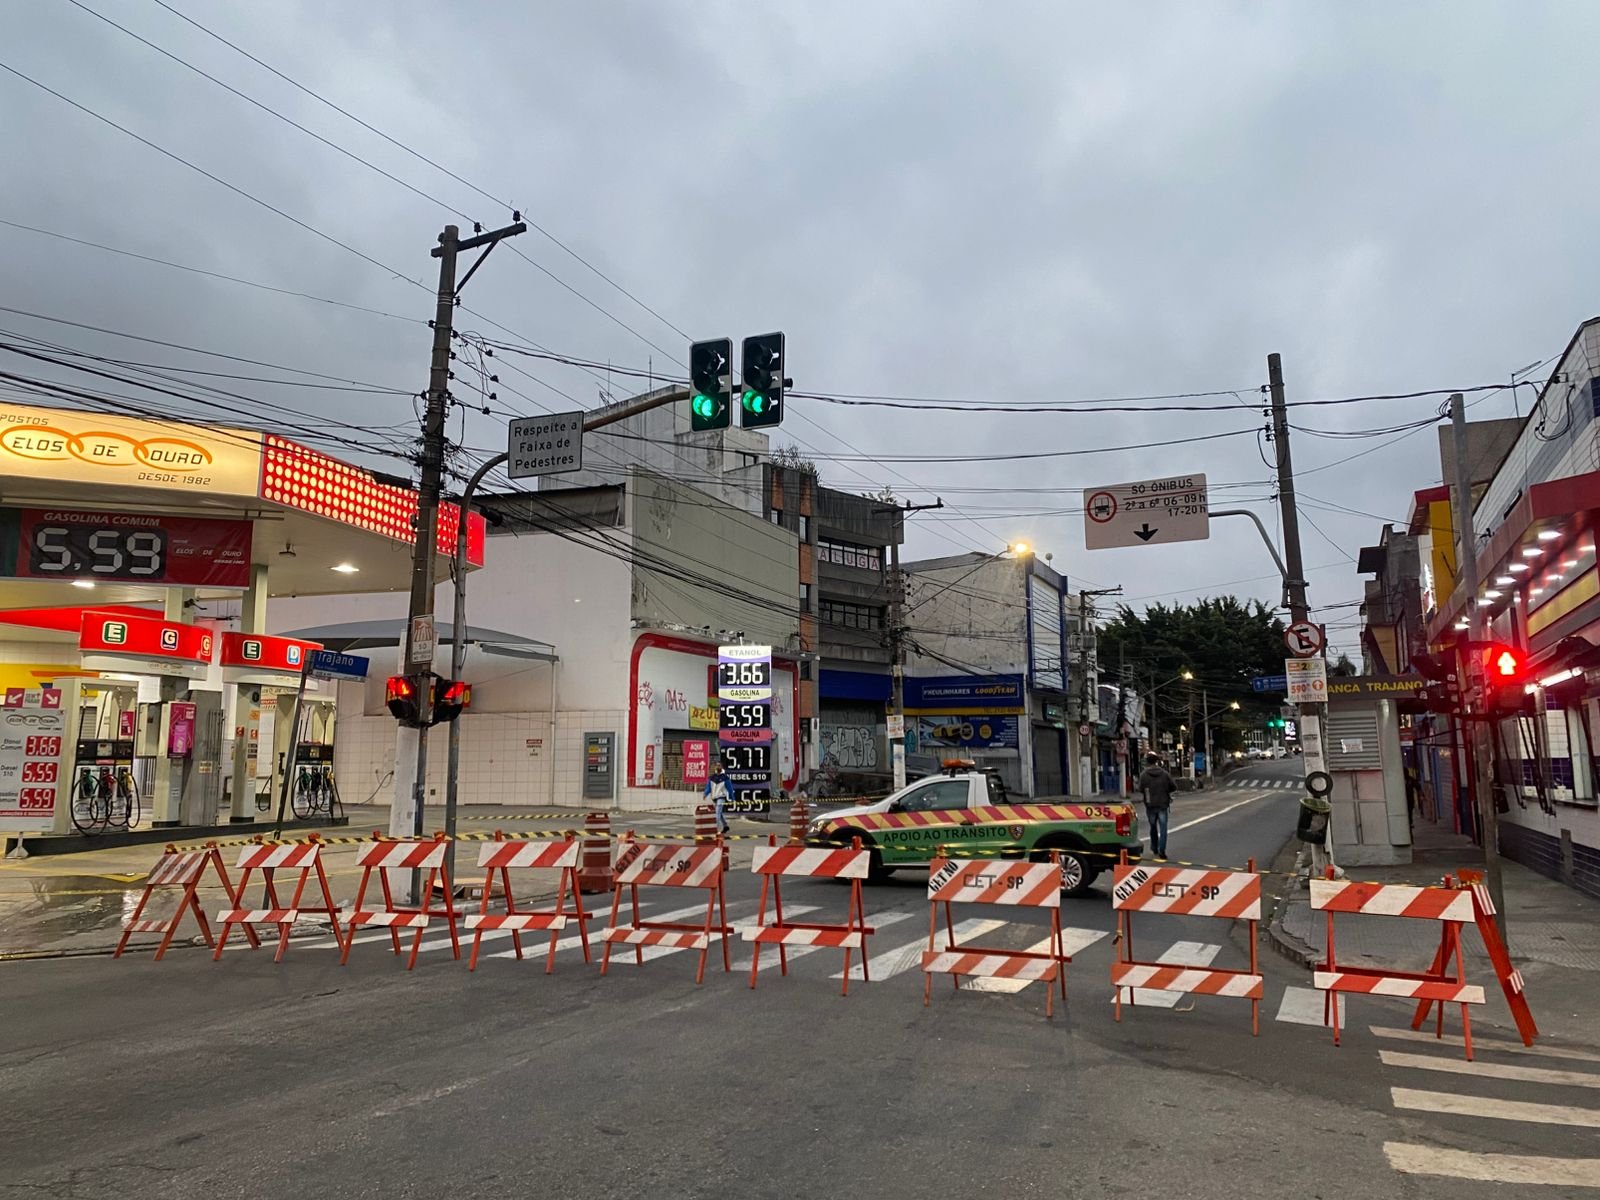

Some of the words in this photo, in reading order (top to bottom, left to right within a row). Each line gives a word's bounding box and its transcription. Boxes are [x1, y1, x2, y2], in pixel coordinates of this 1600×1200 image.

[0, 414, 49, 425] POSTOS
[514, 423, 566, 437] Respeite
[571, 422, 577, 430] a
[12, 437, 64, 452] ELOS
[93, 445, 119, 457] DE
[150, 450, 203, 465] OURO
[520, 441, 552, 453] Faixa
[556, 438, 570, 448] de
[515, 455, 574, 470] Pedestres
[138, 472, 178, 483] DESDE
[182, 476, 211, 485] 1982
[1168, 506, 1198, 517] 17-20
[44, 512, 109, 524] GASOLINA
[112, 516, 160, 527] COMUM
[37, 527, 161, 574] 5,59
[820, 550, 879, 569] ALUGA
[108, 624, 122, 638] E
[164, 632, 175, 644] G
[203, 638, 210, 650] G
[247, 643, 257, 655] E
[290, 648, 298, 659] D
[318, 651, 354, 666] Trajano
[727, 663, 763, 685] 3,66
[1327, 684, 1360, 693] ANCA
[1366, 681, 1424, 691] TRAJANO
[726, 705, 763, 727] 5,59
[726, 747, 764, 768] 5,77
[24, 763, 54, 782] 5,55
[21, 789, 51, 808] 5,59
[1085, 807, 1111, 817] 035
[883, 831, 921, 842] APOIO
[923, 830, 940, 840] AO
[676, 860, 691, 872] SP
[943, 861, 959, 875] NO
[963, 874, 997, 888] CET
[1007, 875, 1024, 889] SP
[1114, 879, 1136, 901] GET
[1132, 868, 1149, 887] NO
[1152, 882, 1189, 898] CET
[1201, 885, 1220, 900] SP
